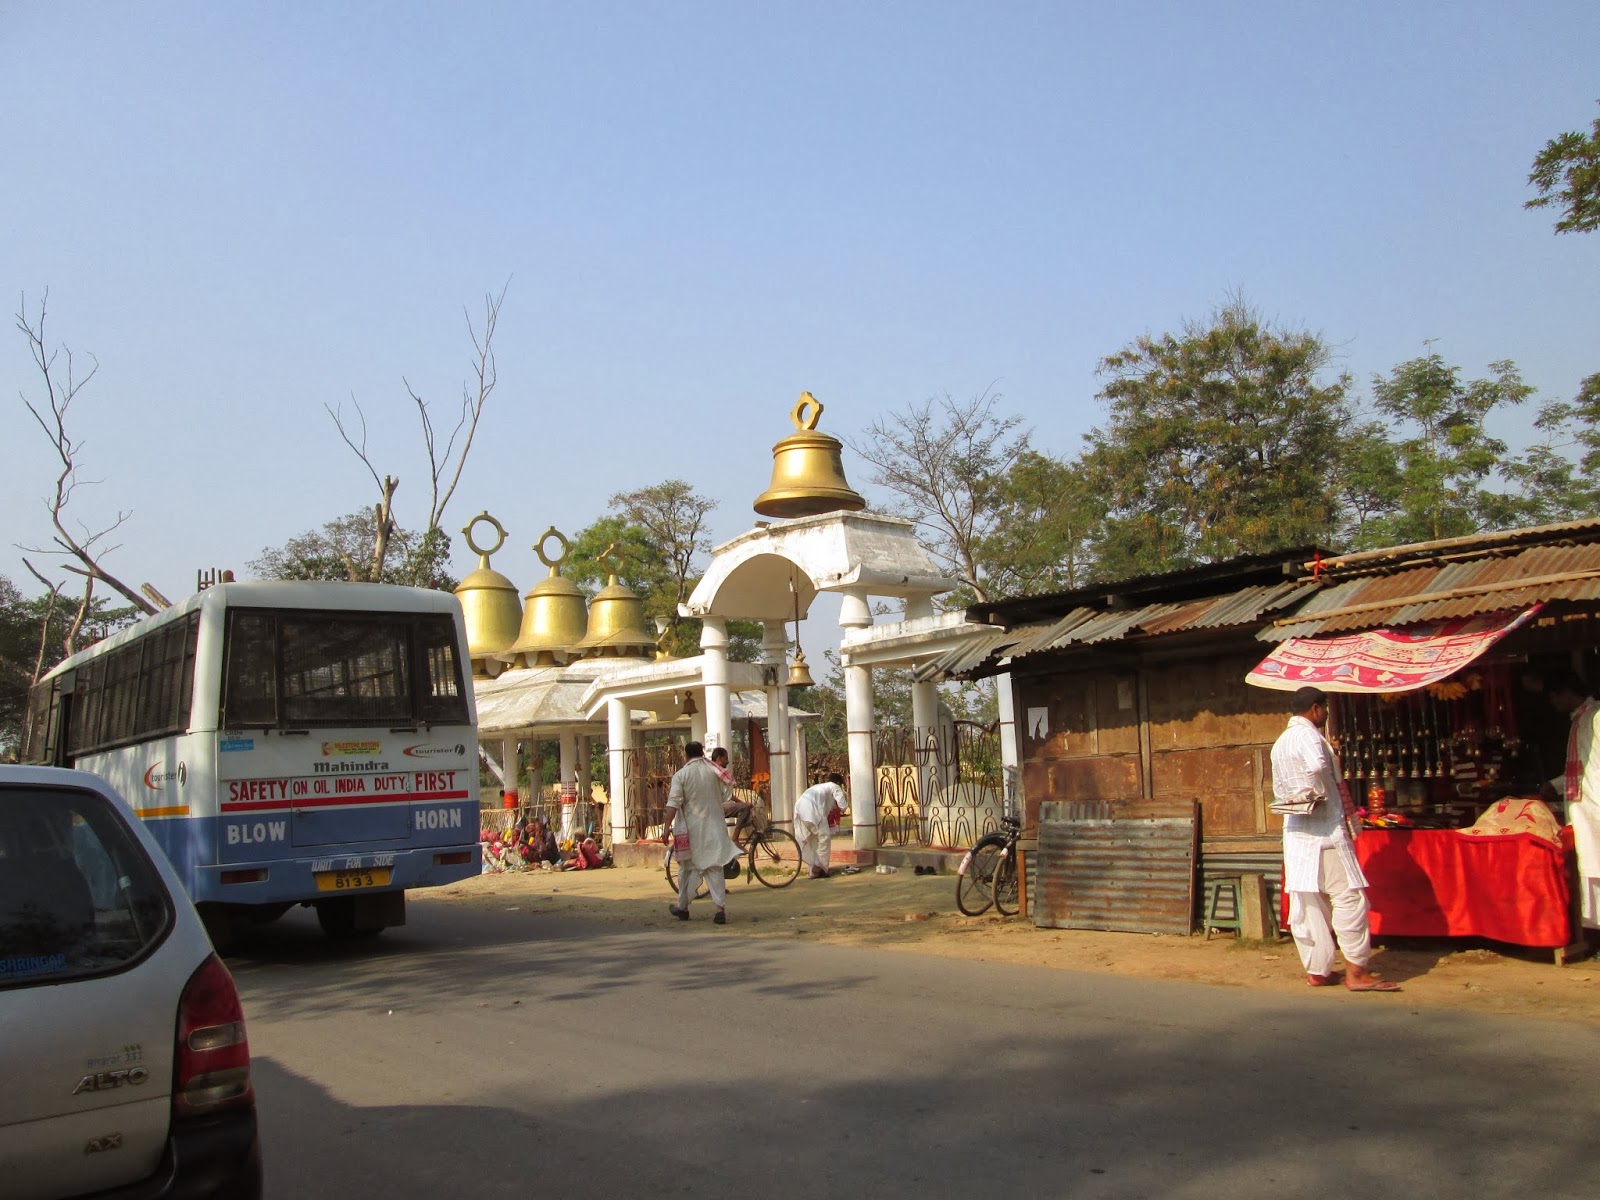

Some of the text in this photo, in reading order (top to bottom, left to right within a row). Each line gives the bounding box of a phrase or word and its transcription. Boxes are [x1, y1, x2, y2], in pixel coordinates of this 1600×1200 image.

[415, 747, 454, 756] tourister
[151, 771, 177, 782] tourister
[229, 771, 456, 802] SAFETY ON OIL INDIA DUTY FIRST
[415, 808, 462, 830] HORN
[227, 821, 286, 845] BLOW
[311, 855, 393, 872] WAIT FOR SIDE
[336, 876, 374, 888] 8133
[0, 953, 65, 972] SHRINGAR
[72, 1067, 149, 1095] ALTO
